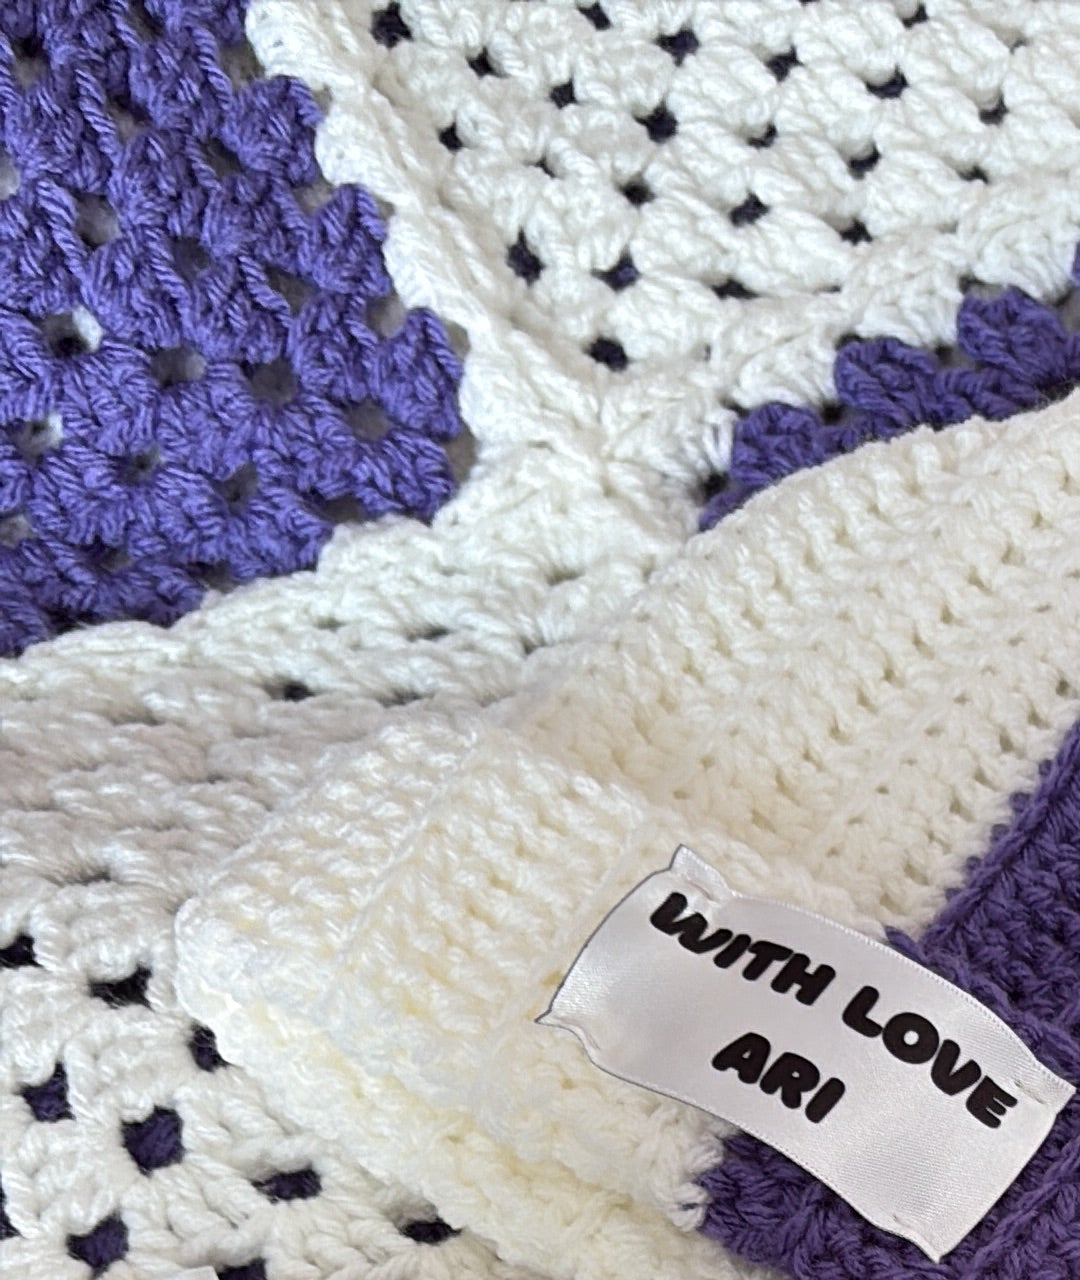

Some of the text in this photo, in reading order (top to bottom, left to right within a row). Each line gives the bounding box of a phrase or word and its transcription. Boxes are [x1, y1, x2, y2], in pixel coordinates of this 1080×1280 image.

[649, 892, 1017, 1128] WITH LOVE
[712, 1032, 845, 1123] ARI
